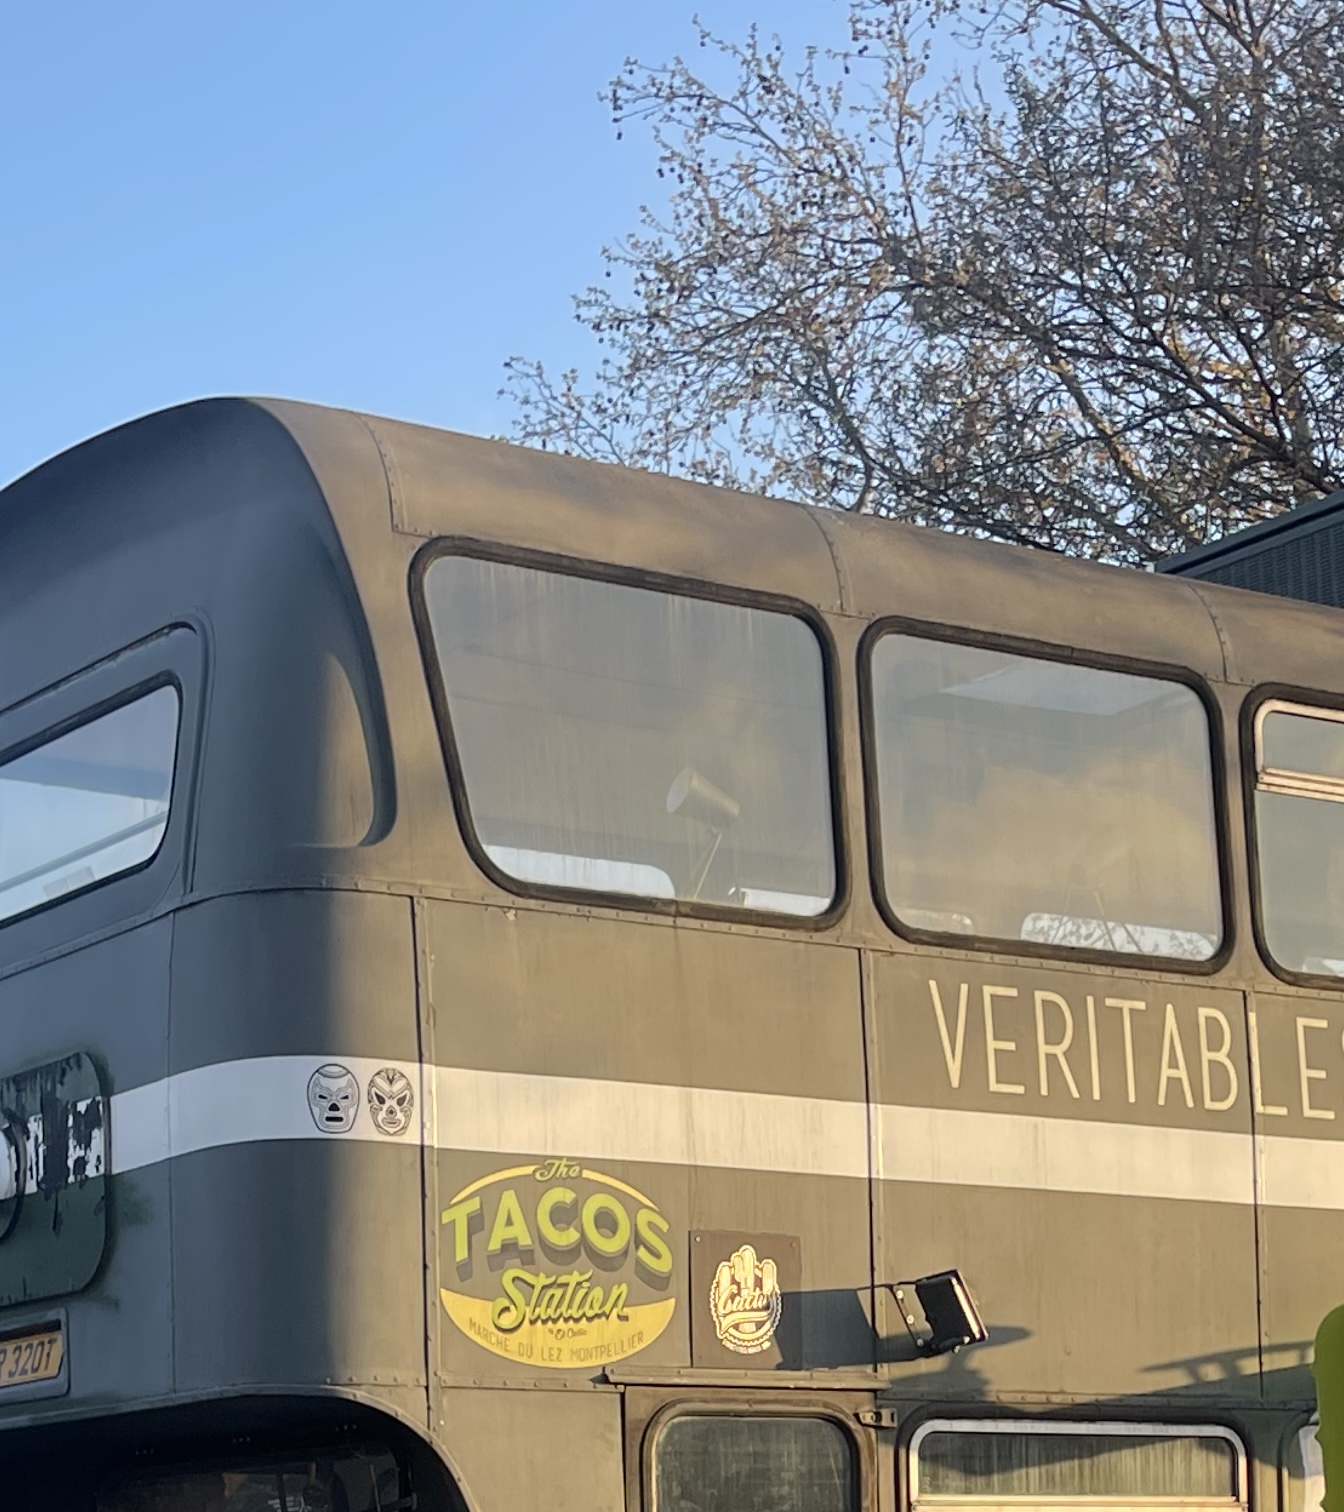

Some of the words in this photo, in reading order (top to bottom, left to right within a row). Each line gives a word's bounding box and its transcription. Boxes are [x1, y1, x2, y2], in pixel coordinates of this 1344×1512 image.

[533, 1158, 582, 1182] The
[440, 1186, 674, 1280] TACOS
[492, 1267, 629, 1332] Station
[8, 1336, 58, 1378] 320T
[517, 1341, 534, 1359] DU
[540, 1346, 563, 1363] LEZ
[570, 1330, 645, 1361] MONTPELLIER
